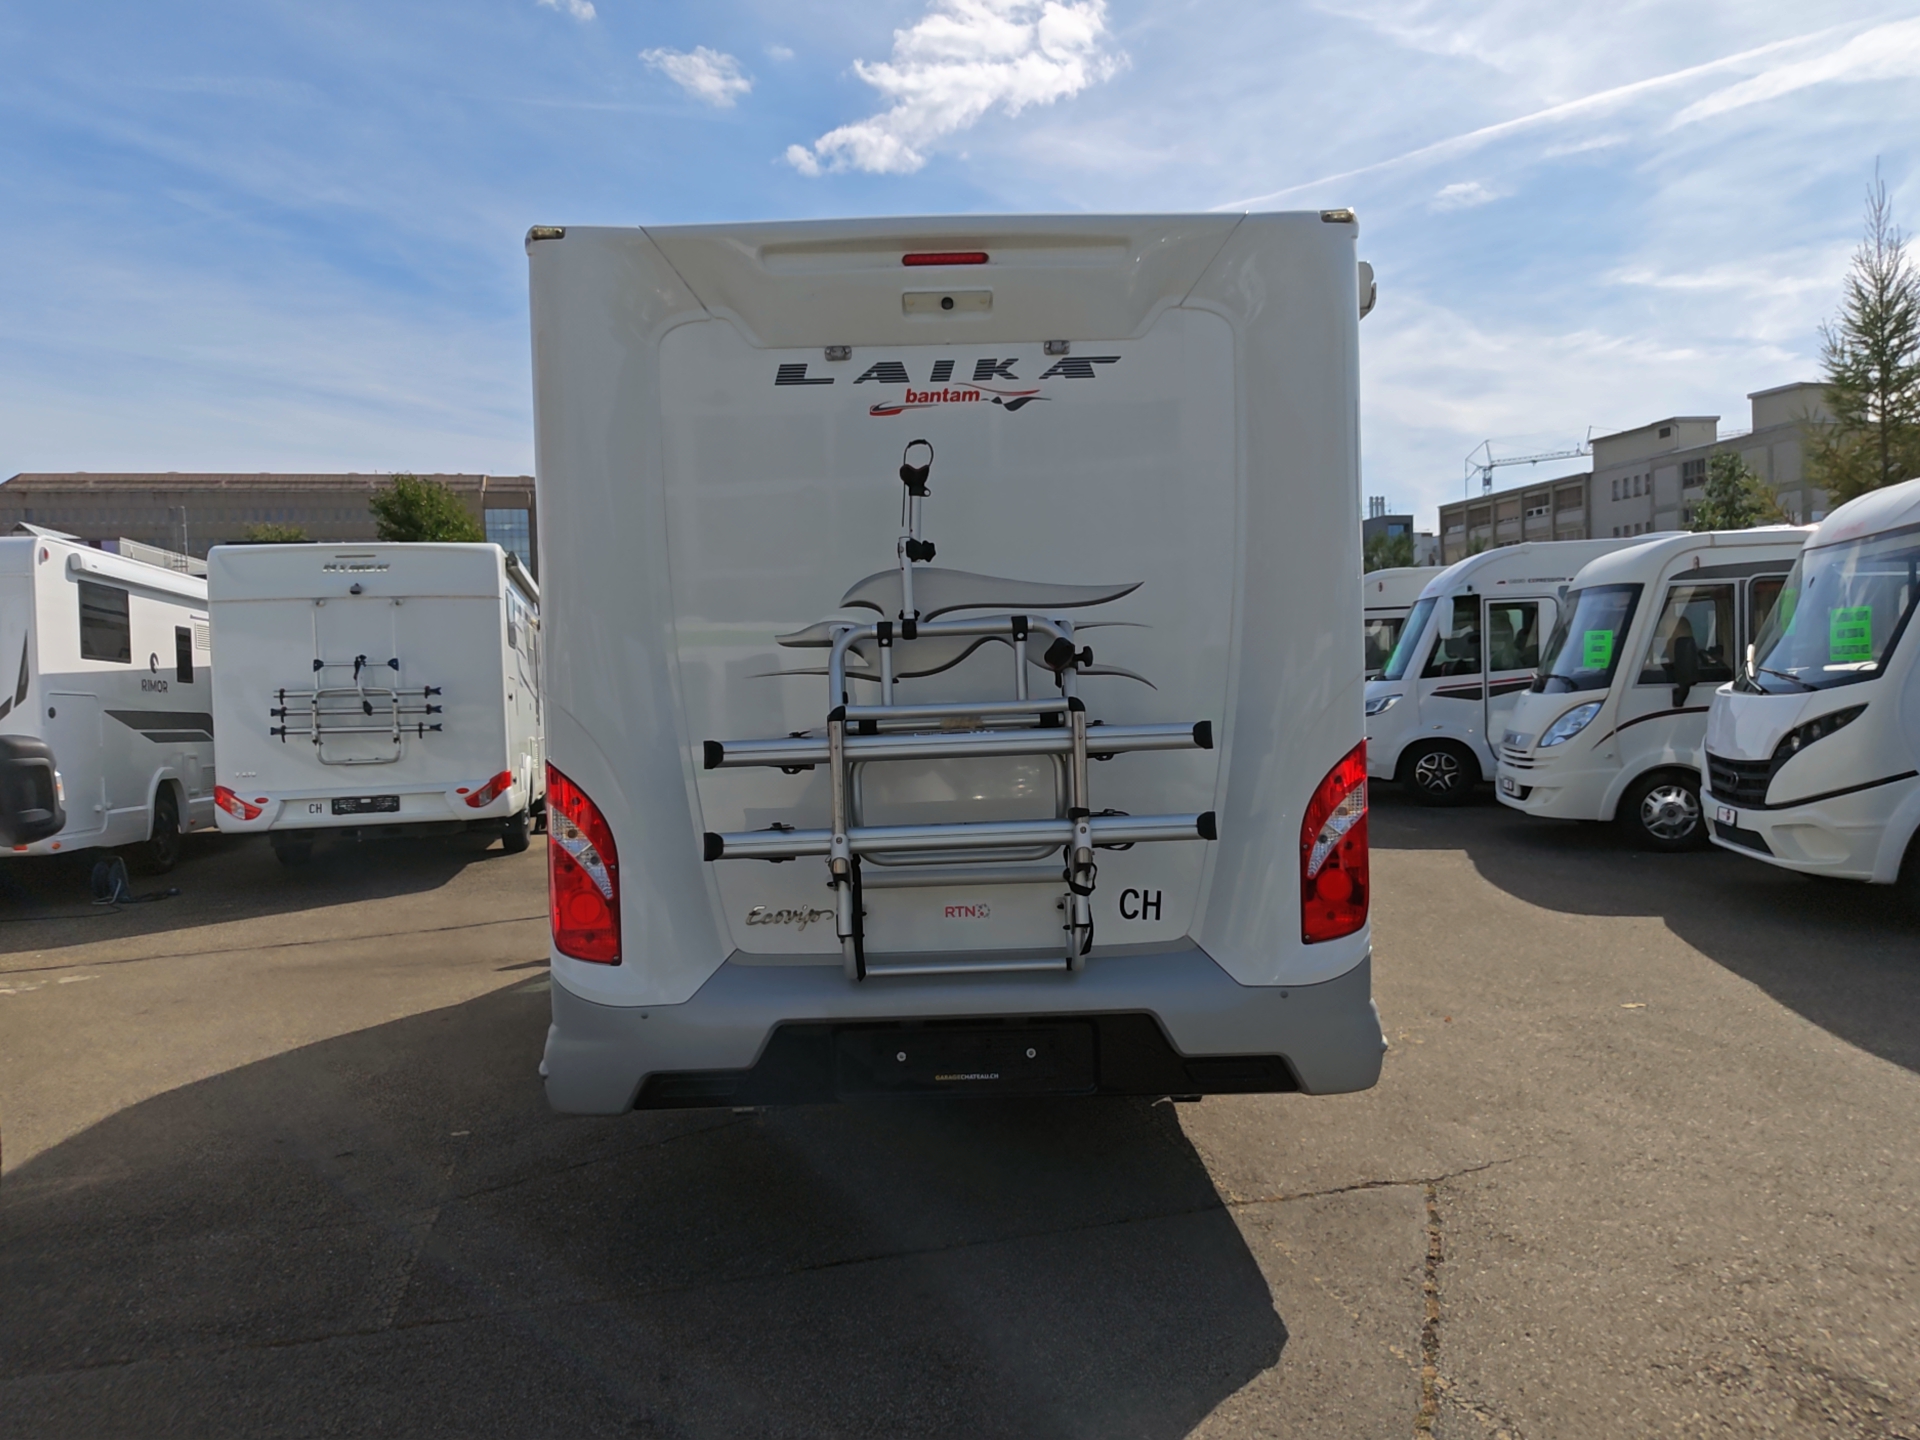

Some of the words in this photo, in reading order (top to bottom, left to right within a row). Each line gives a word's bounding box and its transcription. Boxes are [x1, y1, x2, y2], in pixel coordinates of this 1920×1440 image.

[775, 356, 1122, 386] LAIKA
[905, 387, 981, 404] bantam
[141, 678, 168, 694] RIMOR
[309, 803, 322, 814] CH
[945, 905, 976, 918] RTN
[1119, 888, 1162, 921] CH
[935, 1073, 999, 1081] GARAGECHATEAU.CH
